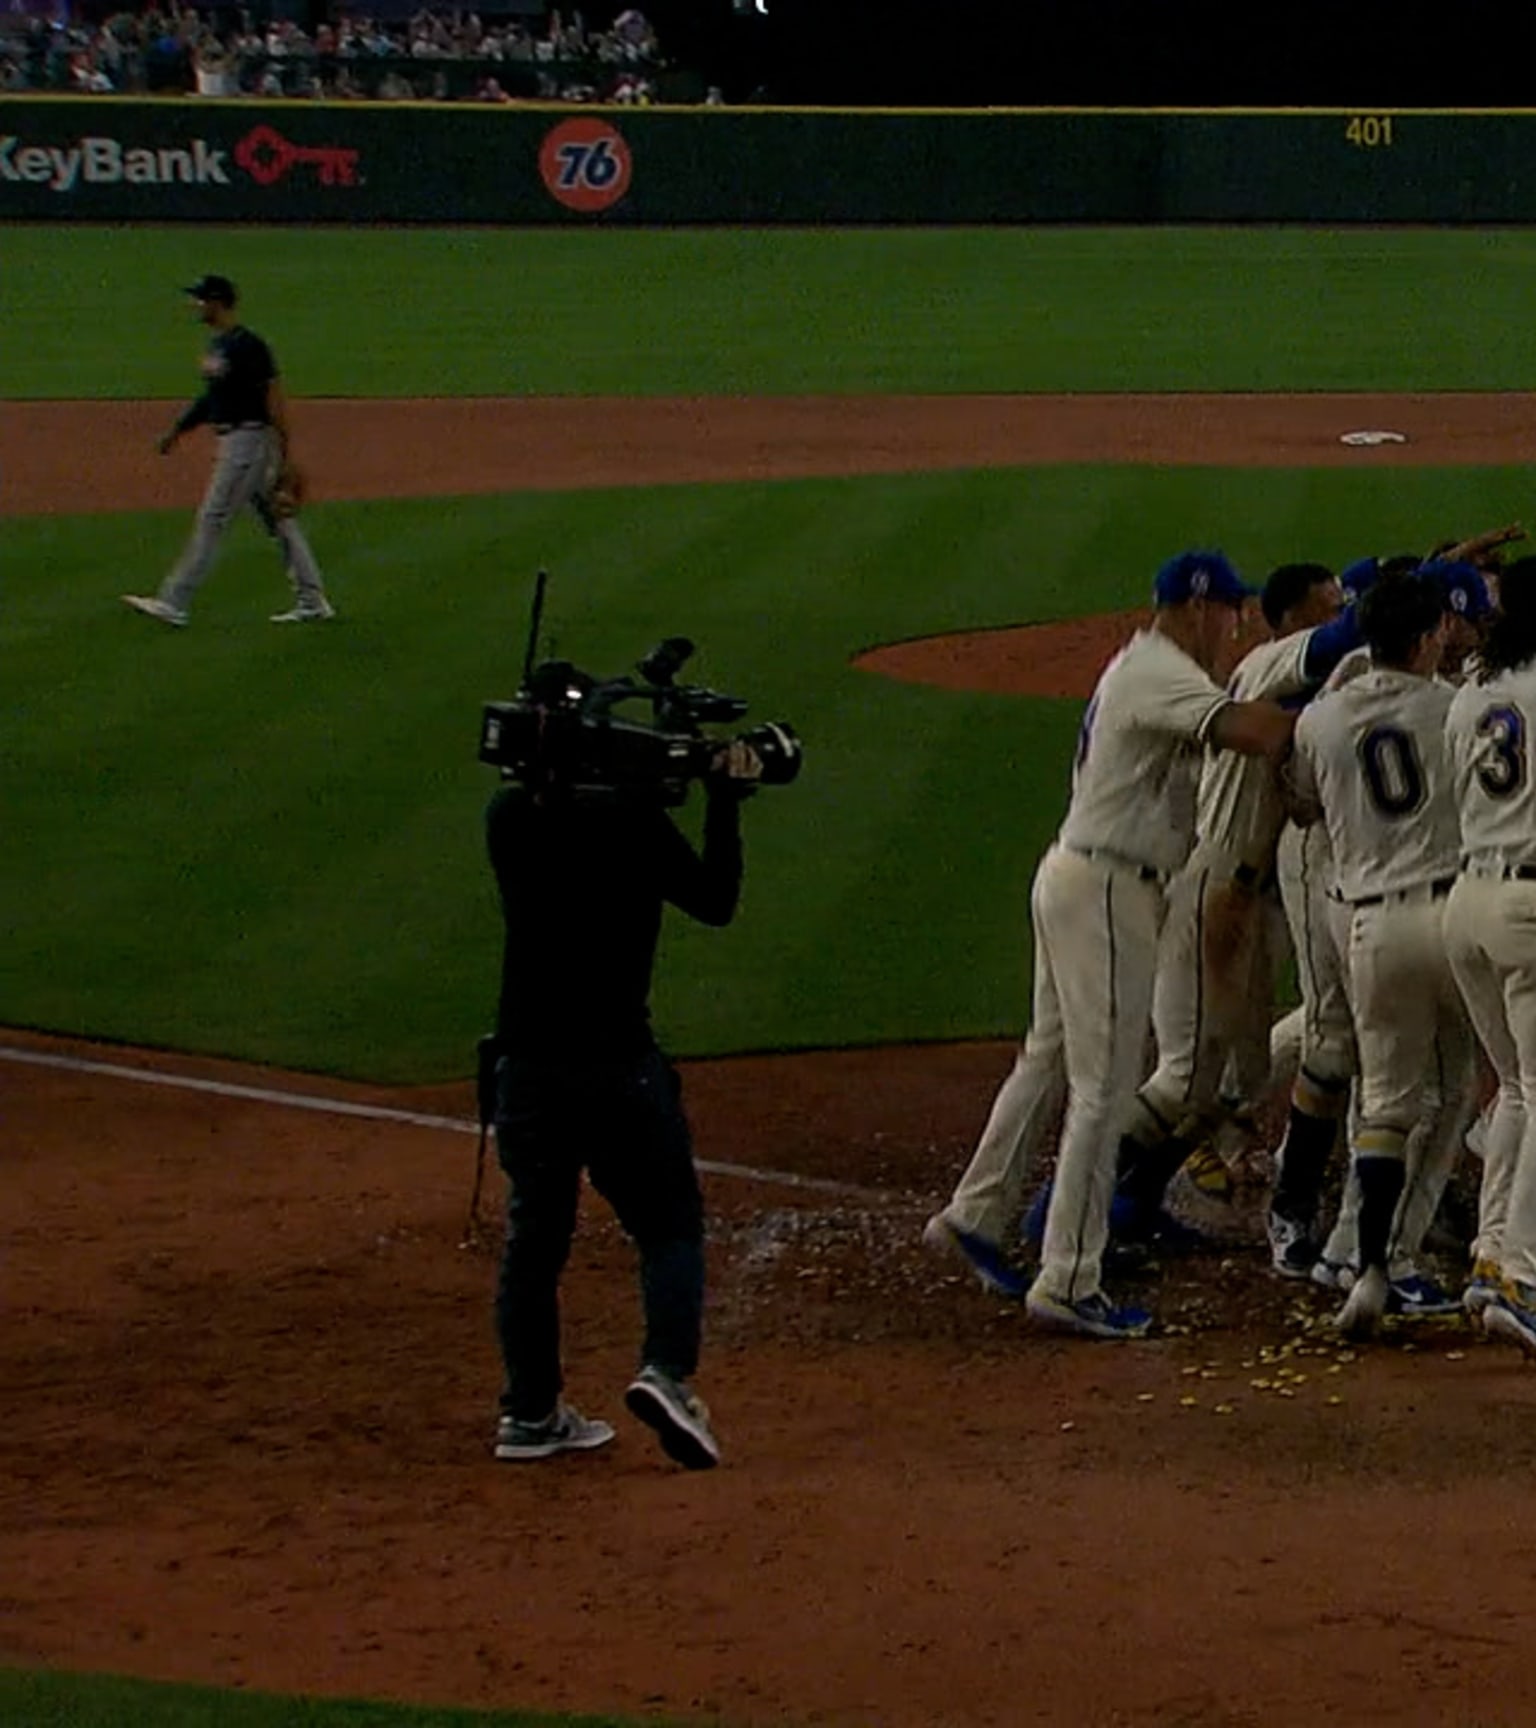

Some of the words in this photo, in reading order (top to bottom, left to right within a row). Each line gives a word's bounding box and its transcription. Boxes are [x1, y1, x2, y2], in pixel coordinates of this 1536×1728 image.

[555, 137, 622, 191] 76
[1344, 116, 1393, 147] 401
[1360, 725, 1425, 817] 0
[1477, 703, 1526, 798] 3
